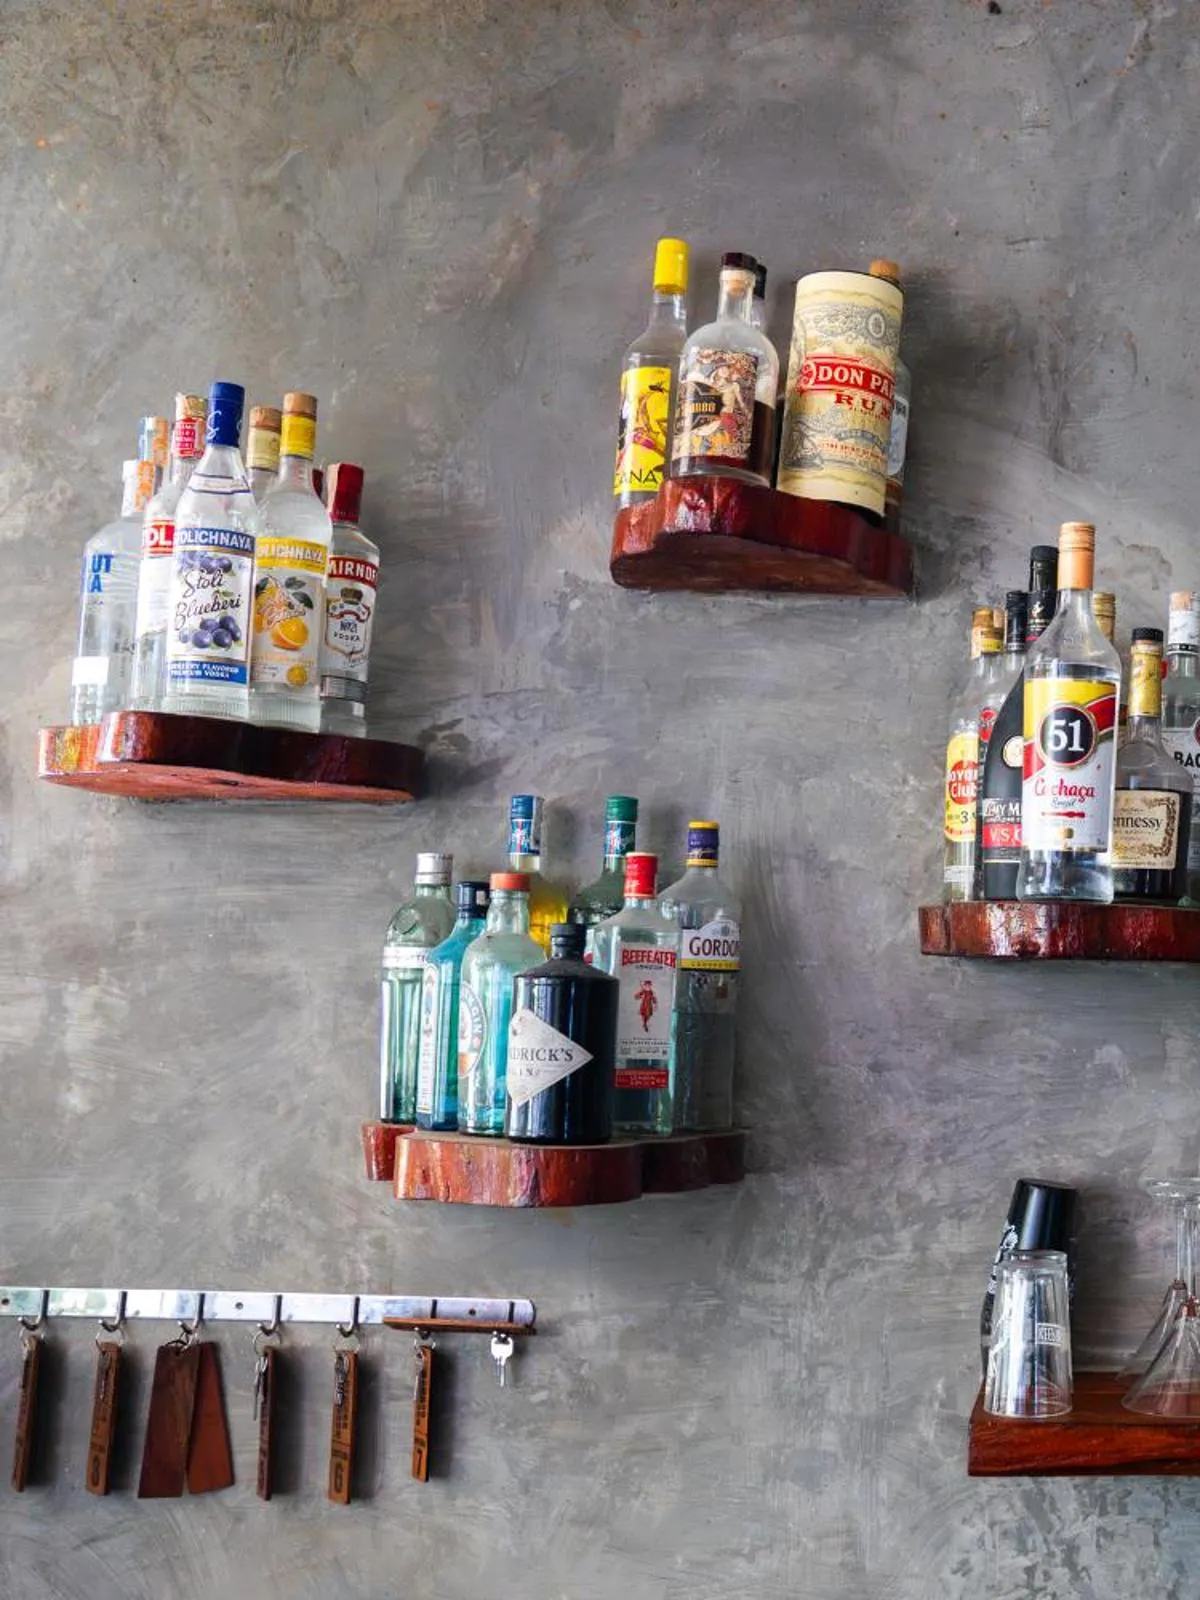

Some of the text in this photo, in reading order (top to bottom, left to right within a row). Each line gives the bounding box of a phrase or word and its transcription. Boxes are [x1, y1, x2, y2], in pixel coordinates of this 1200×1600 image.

[818, 365, 864, 387] DON
[91, 554, 114, 574] UT
[91, 574, 103, 593] A
[183, 568, 225, 599] Stoli
[174, 594, 242, 631] Blueberi
[333, 633, 361, 643] VODKA
[1049, 719, 1085, 752] 51
[960, 811, 969, 824] 3
[622, 948, 676, 969] BEEFEATER
[511, 1047, 574, 1062] DRICK'S
